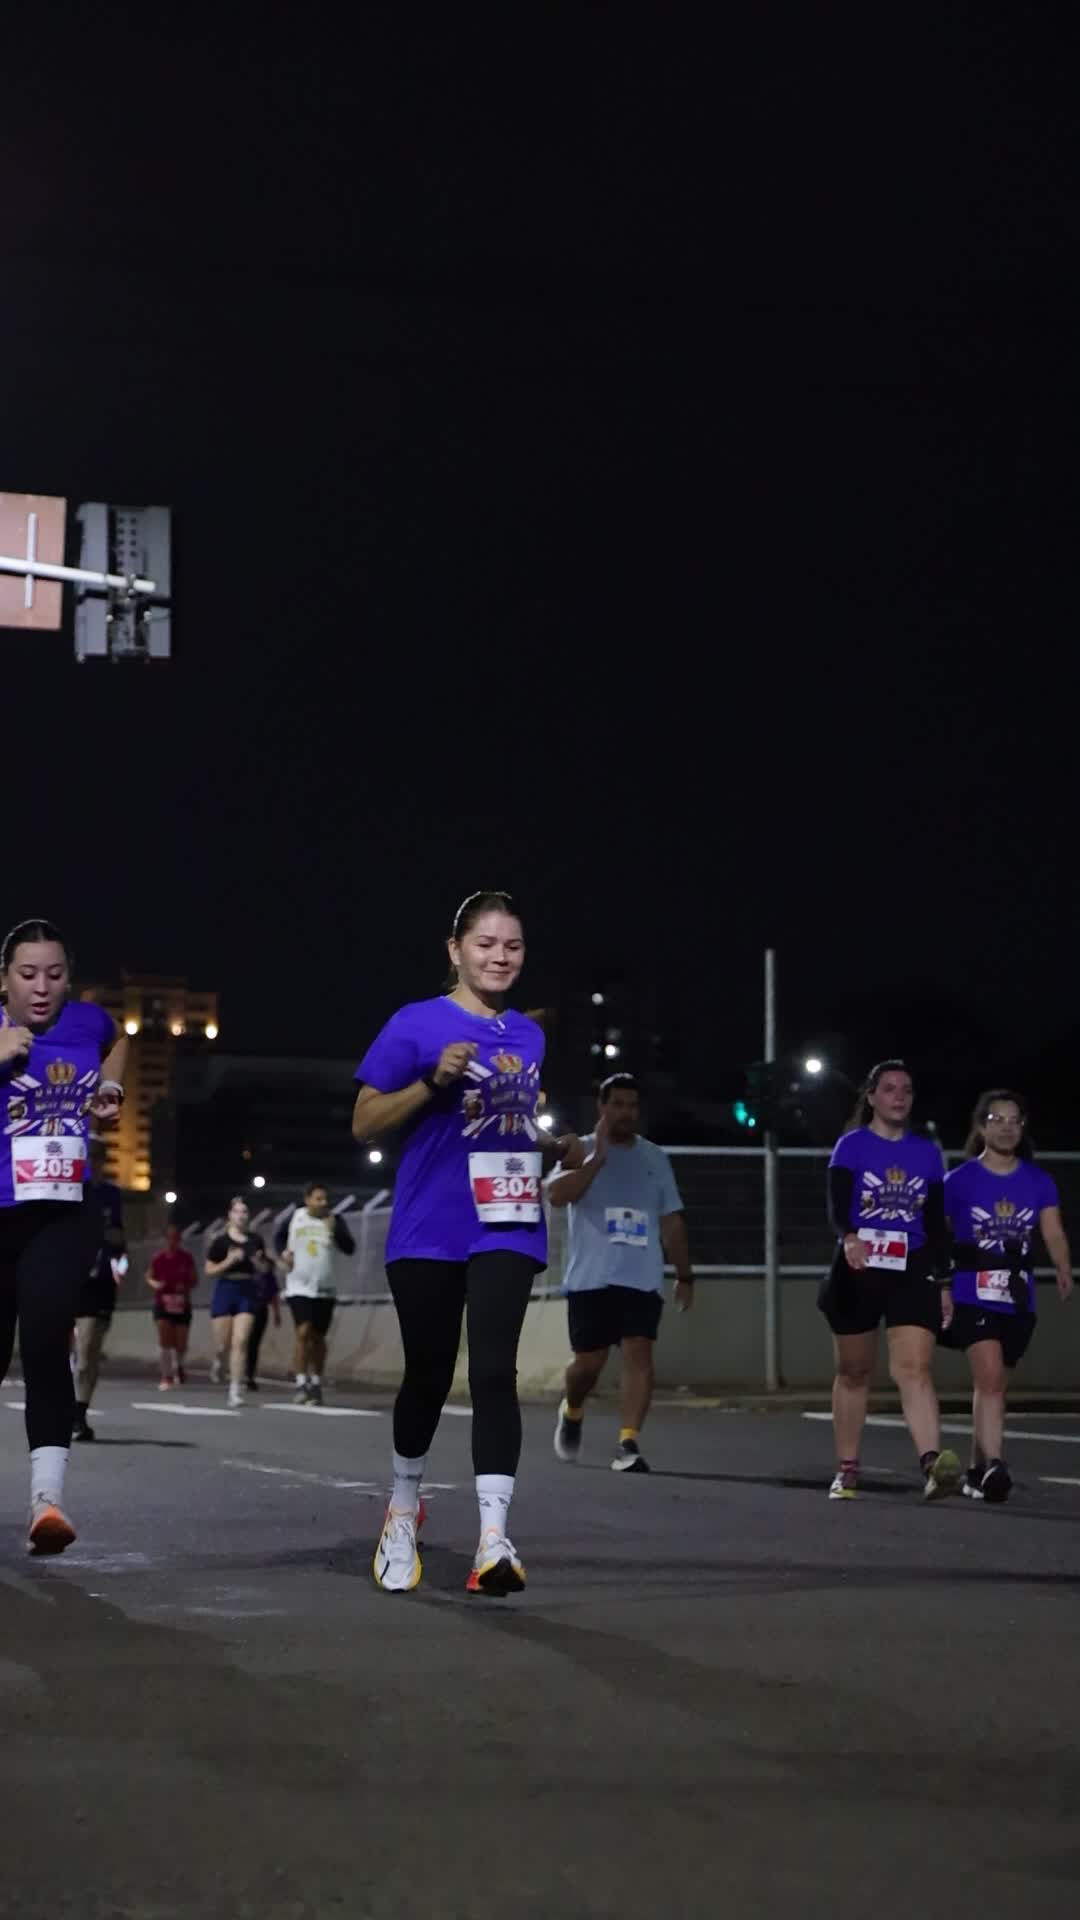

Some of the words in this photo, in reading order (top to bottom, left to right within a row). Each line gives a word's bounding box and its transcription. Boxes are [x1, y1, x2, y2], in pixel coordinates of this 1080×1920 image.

[32, 1159, 74, 1177] 205
[492, 1178, 539, 1197] 304
[870, 1241, 890, 1253] 77
